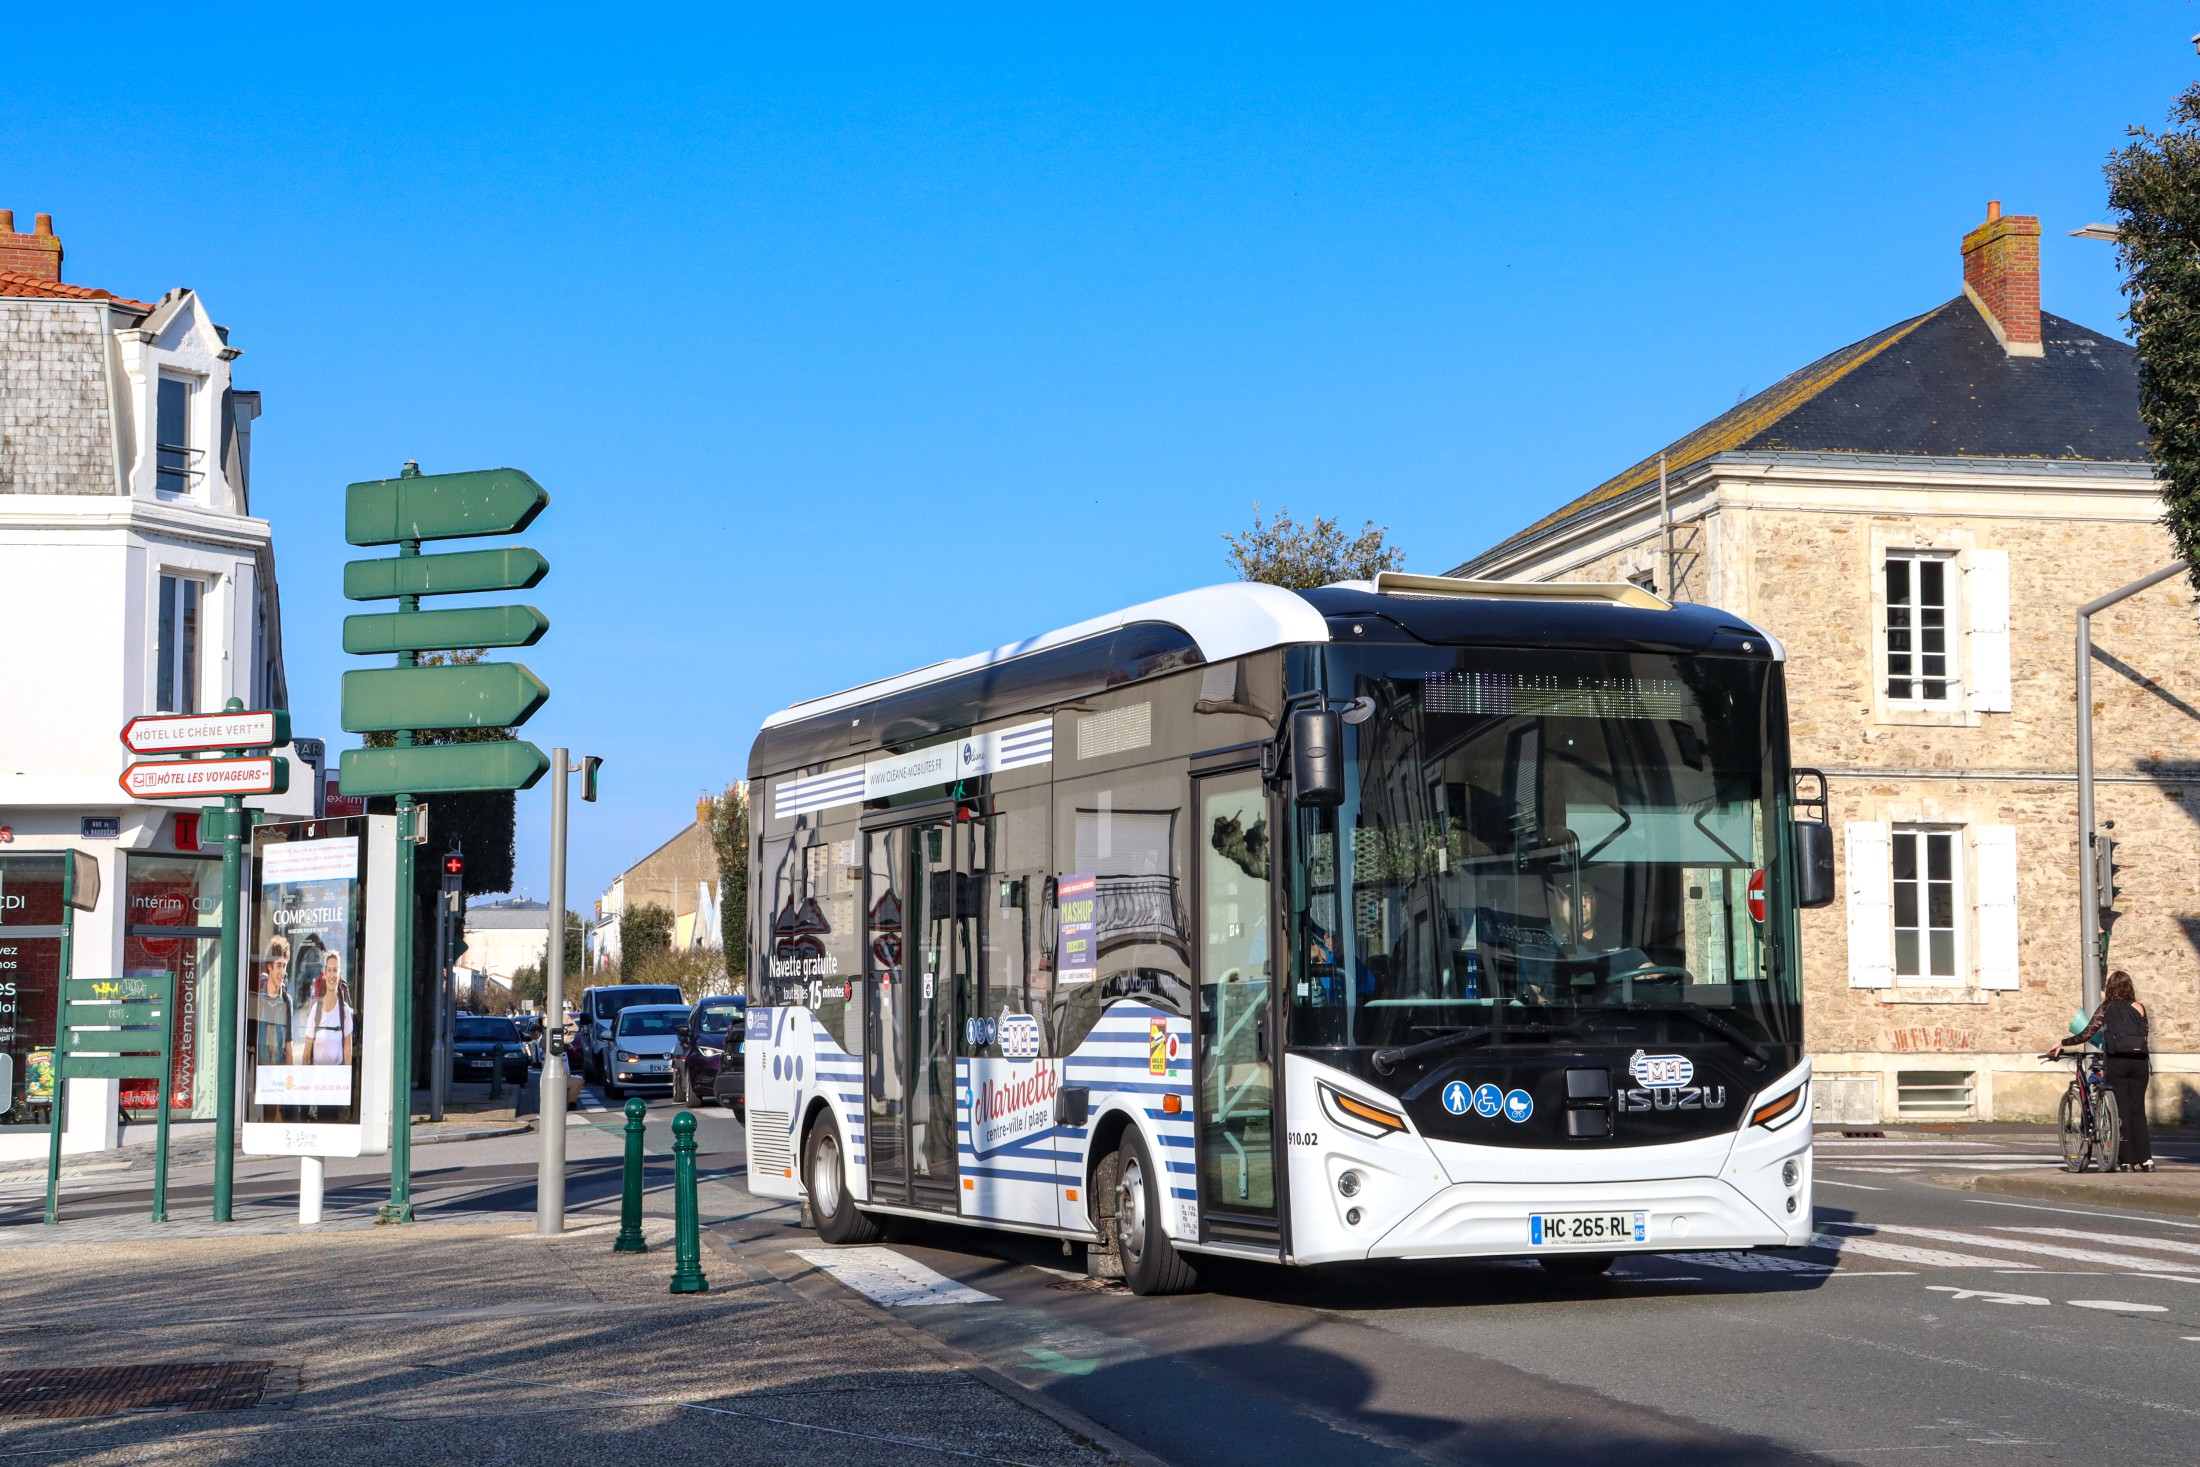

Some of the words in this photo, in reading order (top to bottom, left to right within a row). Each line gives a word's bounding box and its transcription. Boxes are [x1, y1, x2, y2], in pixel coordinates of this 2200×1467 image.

[136, 728, 169, 741] HÔTEL
[173, 727, 185, 738] LE
[188, 723, 222, 737] CHÊNE
[157, 772, 185, 785] HÔTEL
[187, 773, 203, 783] LES
[273, 906, 343, 925] COMPOSTELLE
[1061, 899, 1094, 923] MASHUP
[769, 955, 801, 978] Navette
[803, 951, 838, 982] gratuite
[809, 980, 823, 1010] 15
[822, 984, 845, 998] minutes
[180, 952, 196, 1100] www.temporis.fr
[1009, 1024, 1031, 1055] M1
[1630, 1049, 1645, 1074] gratuit
[1646, 1060, 1681, 1082] M1
[975, 1058, 1058, 1125] Marinette
[1618, 1086, 1726, 1112] ISUZU
[986, 1117, 1023, 1142] centre-ville
[1028, 1109, 1048, 1131] plage
[1288, 1132, 1318, 1145] 910.02
[1635, 1228, 1645, 1238] 85
